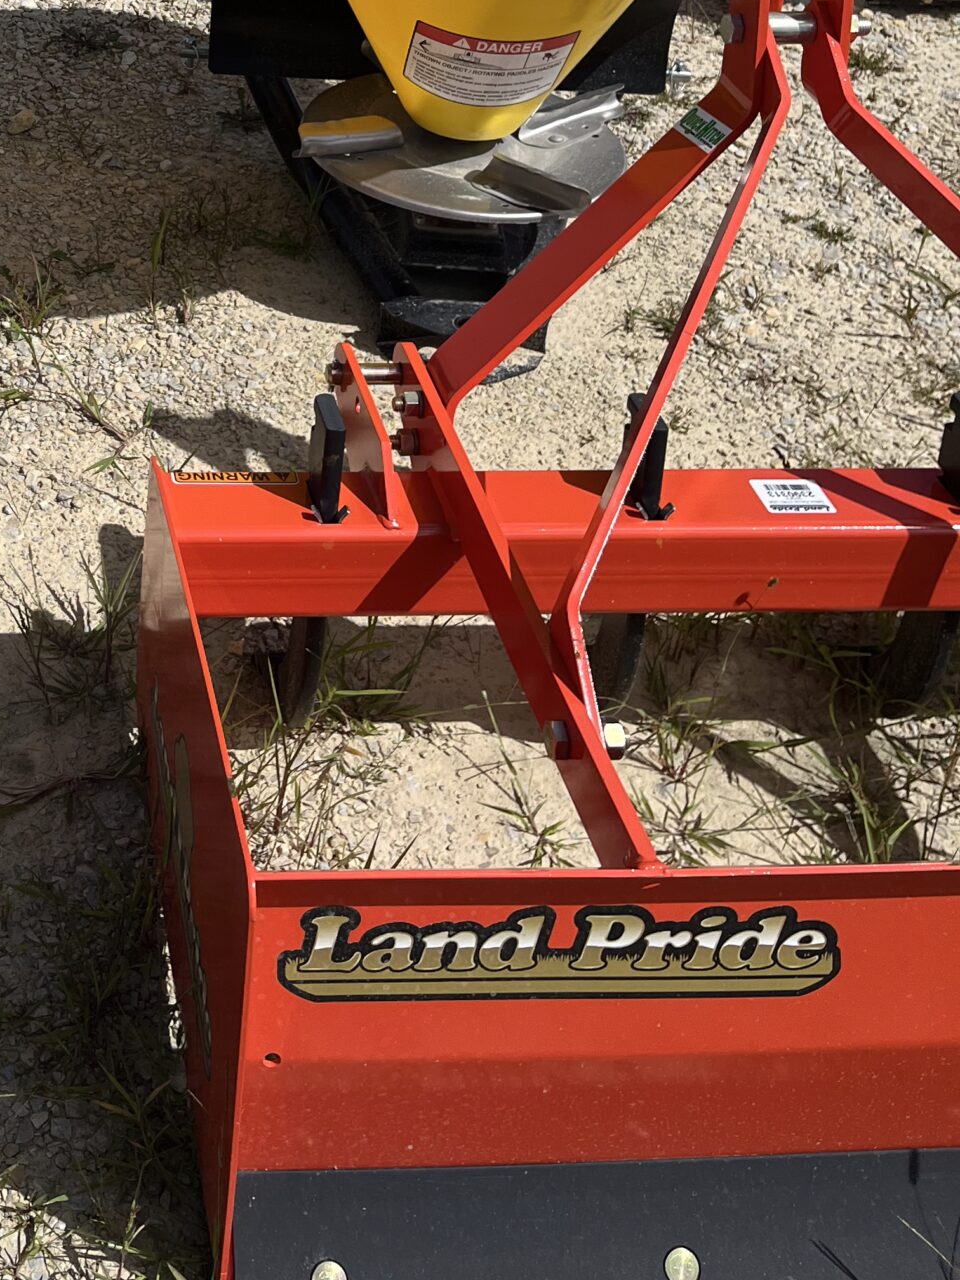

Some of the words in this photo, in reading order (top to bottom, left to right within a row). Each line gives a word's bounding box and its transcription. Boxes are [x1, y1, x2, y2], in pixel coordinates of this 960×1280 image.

[476, 41, 543, 54] DANGER
[177, 472, 270, 481] WARNING
[296, 914, 548, 973] Land
[570, 914, 829, 973] Pride
